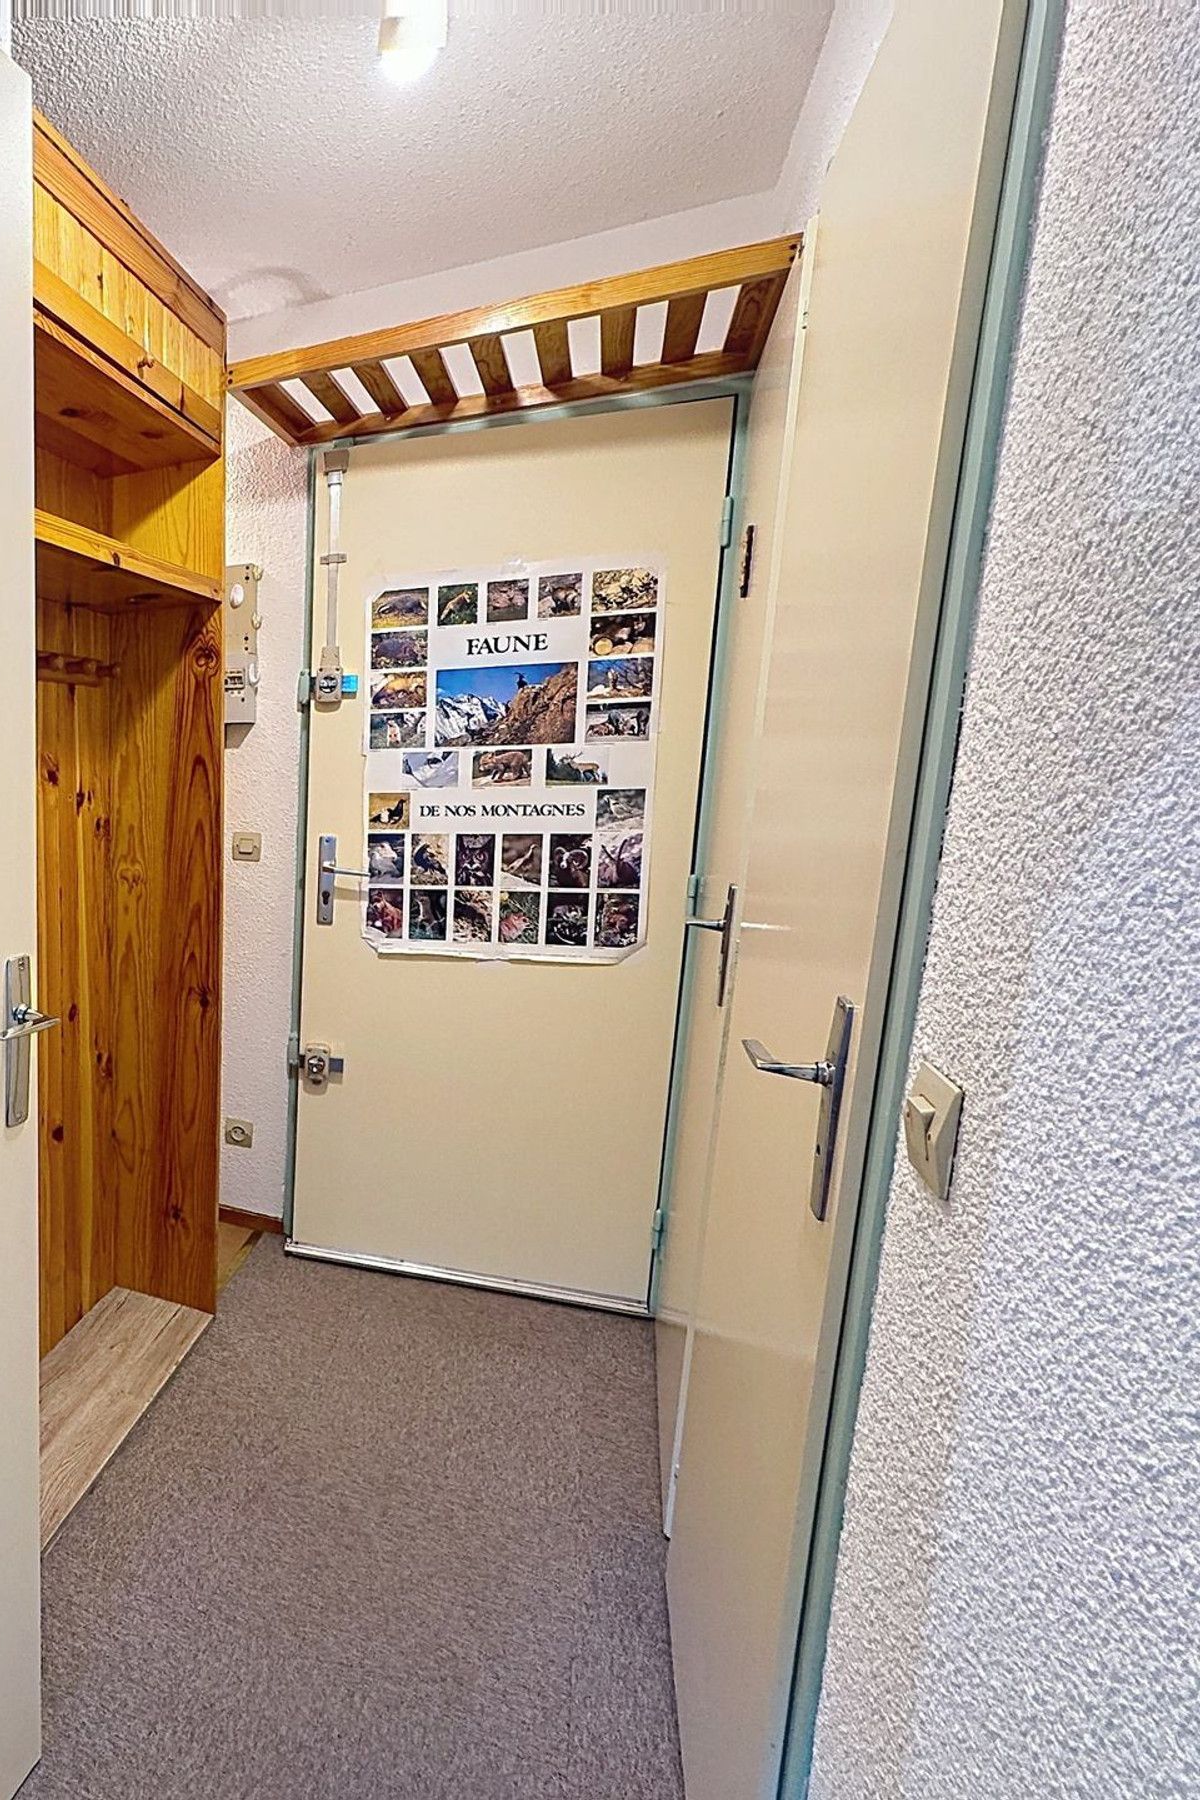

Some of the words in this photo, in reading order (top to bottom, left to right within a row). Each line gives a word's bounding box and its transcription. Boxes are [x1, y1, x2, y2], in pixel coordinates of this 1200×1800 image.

[466, 633, 548, 655] FAUNE
[419, 805, 440, 817] DE
[444, 804, 476, 817] NOS
[481, 803, 585, 817] MONTAGNES
